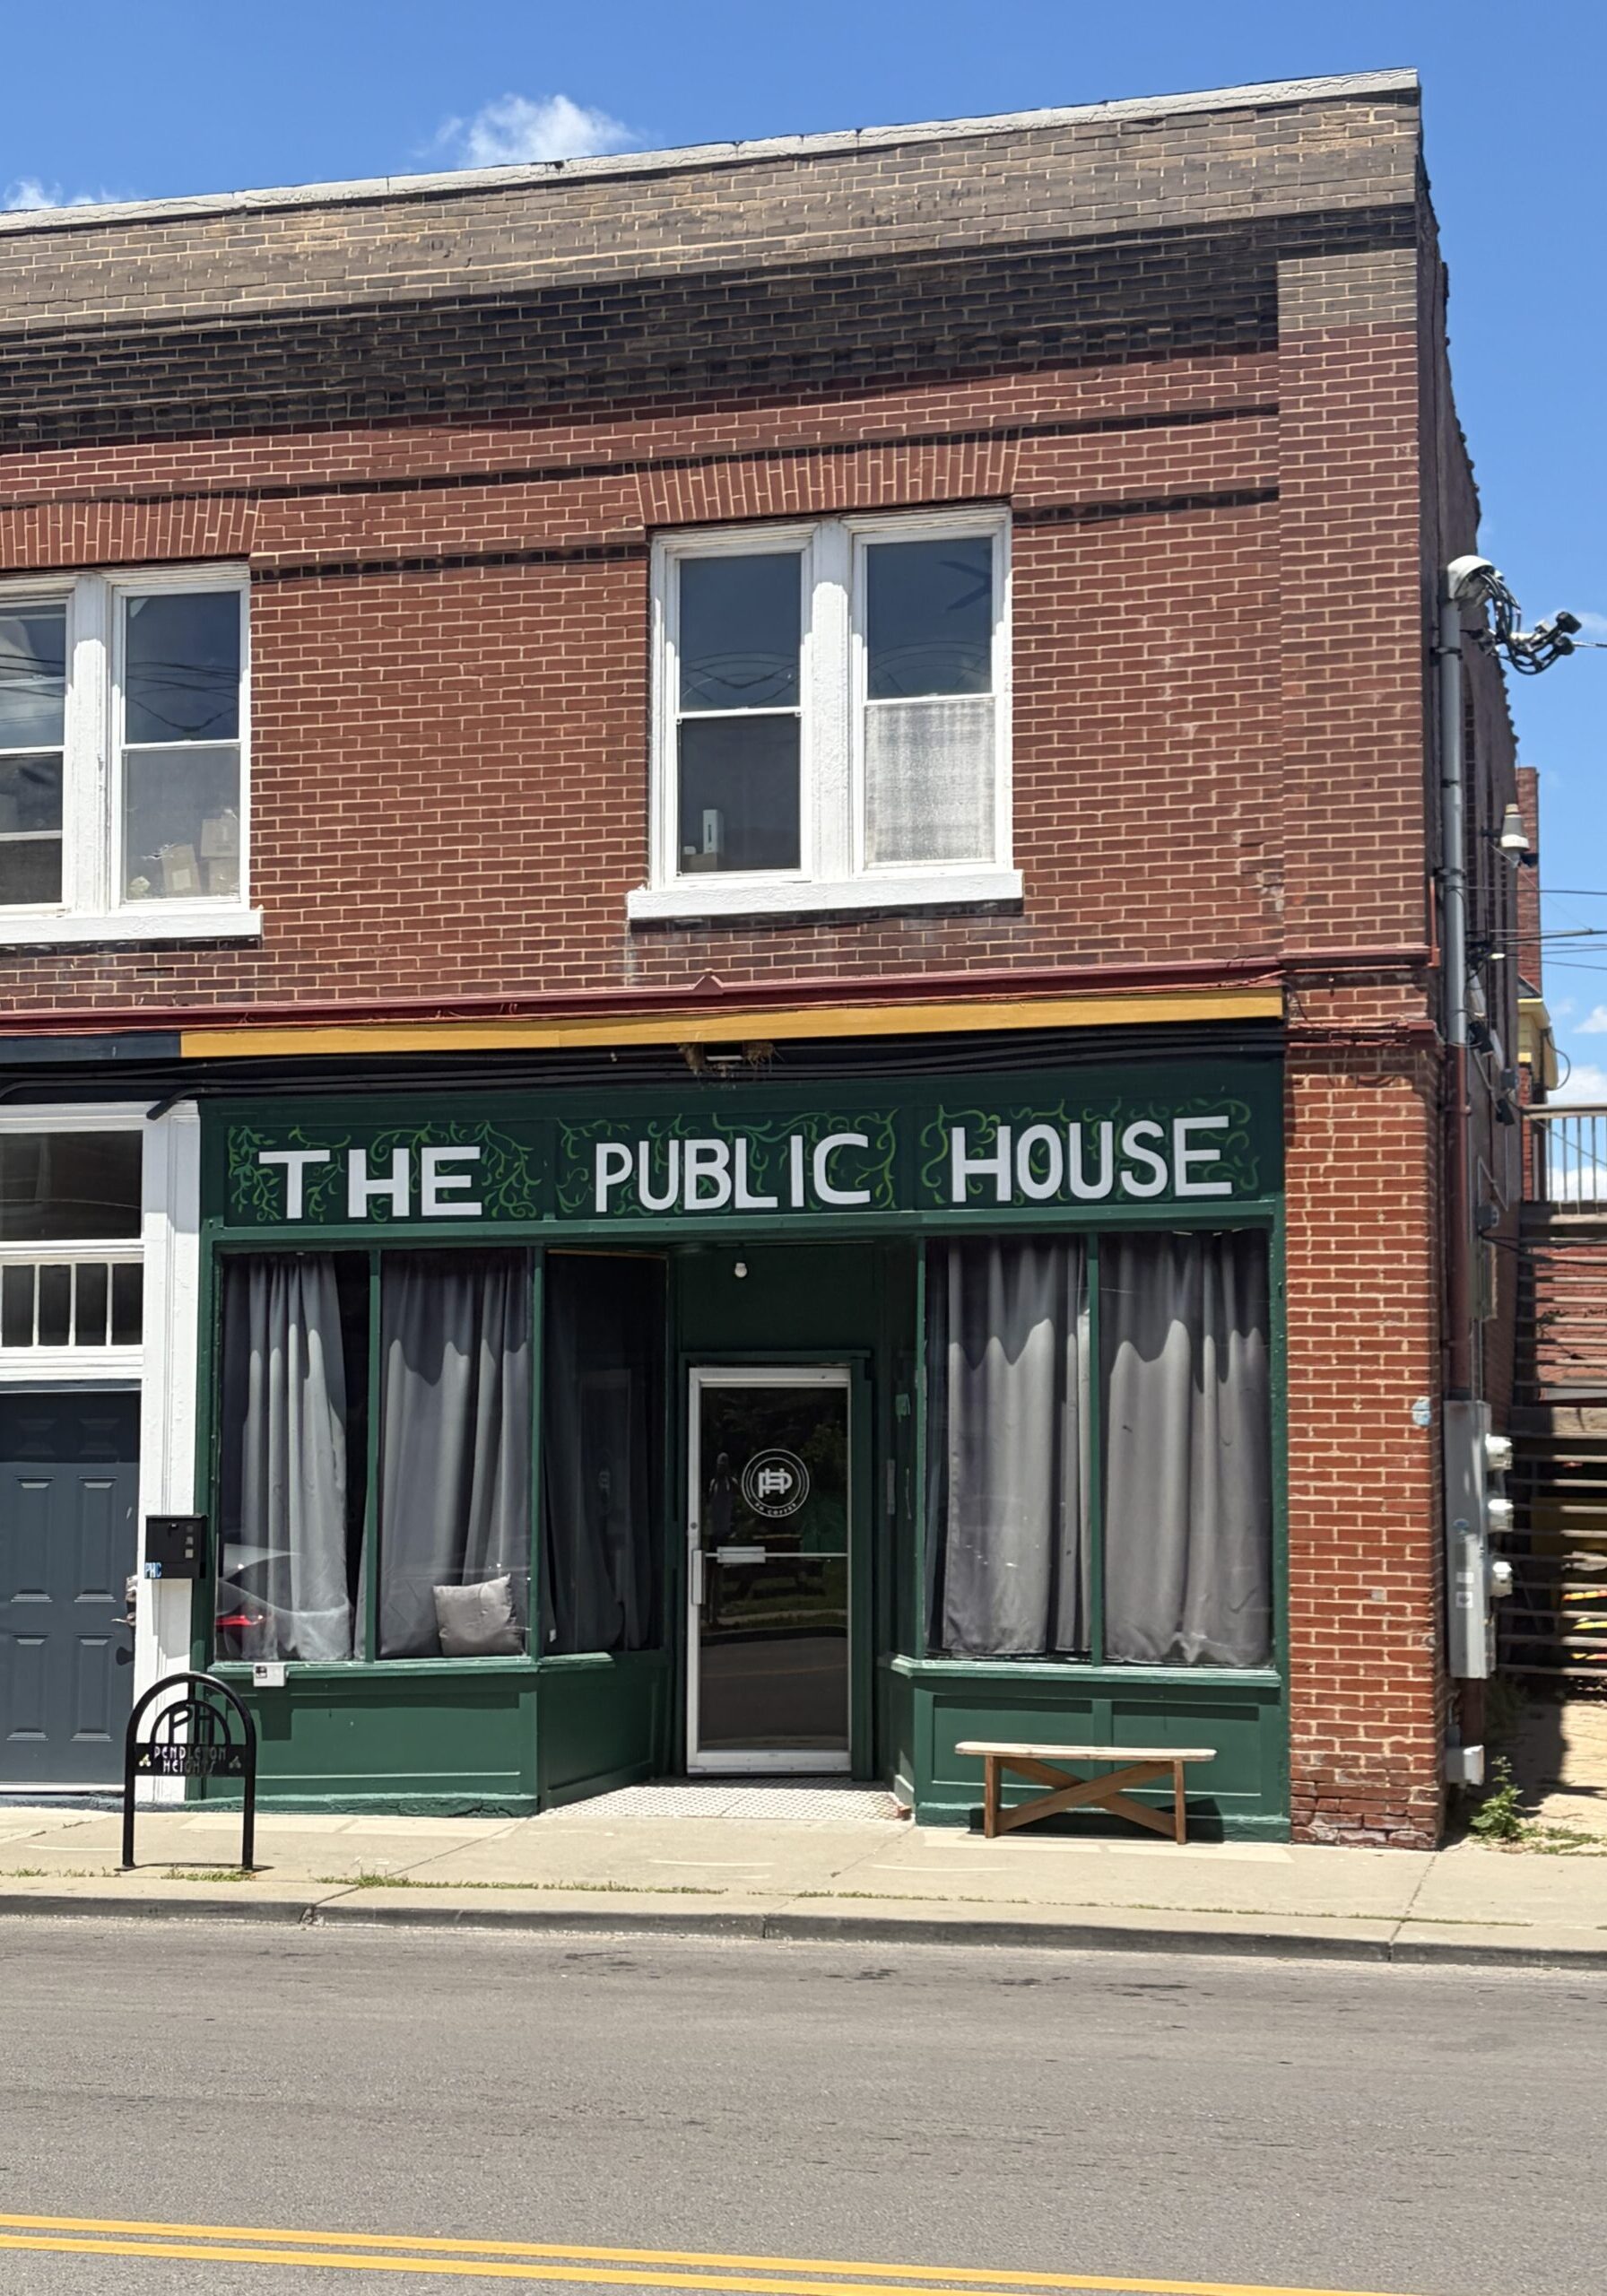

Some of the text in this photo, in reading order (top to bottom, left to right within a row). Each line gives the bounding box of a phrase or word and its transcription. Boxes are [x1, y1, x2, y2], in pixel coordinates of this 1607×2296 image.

[259, 1116, 1233, 1220] THE PUBLIC HOUSE
[767, 1502, 796, 1515] COFFEE
[143, 1561, 162, 1578] PHC
[153, 1745, 227, 1761] PENDLEON
